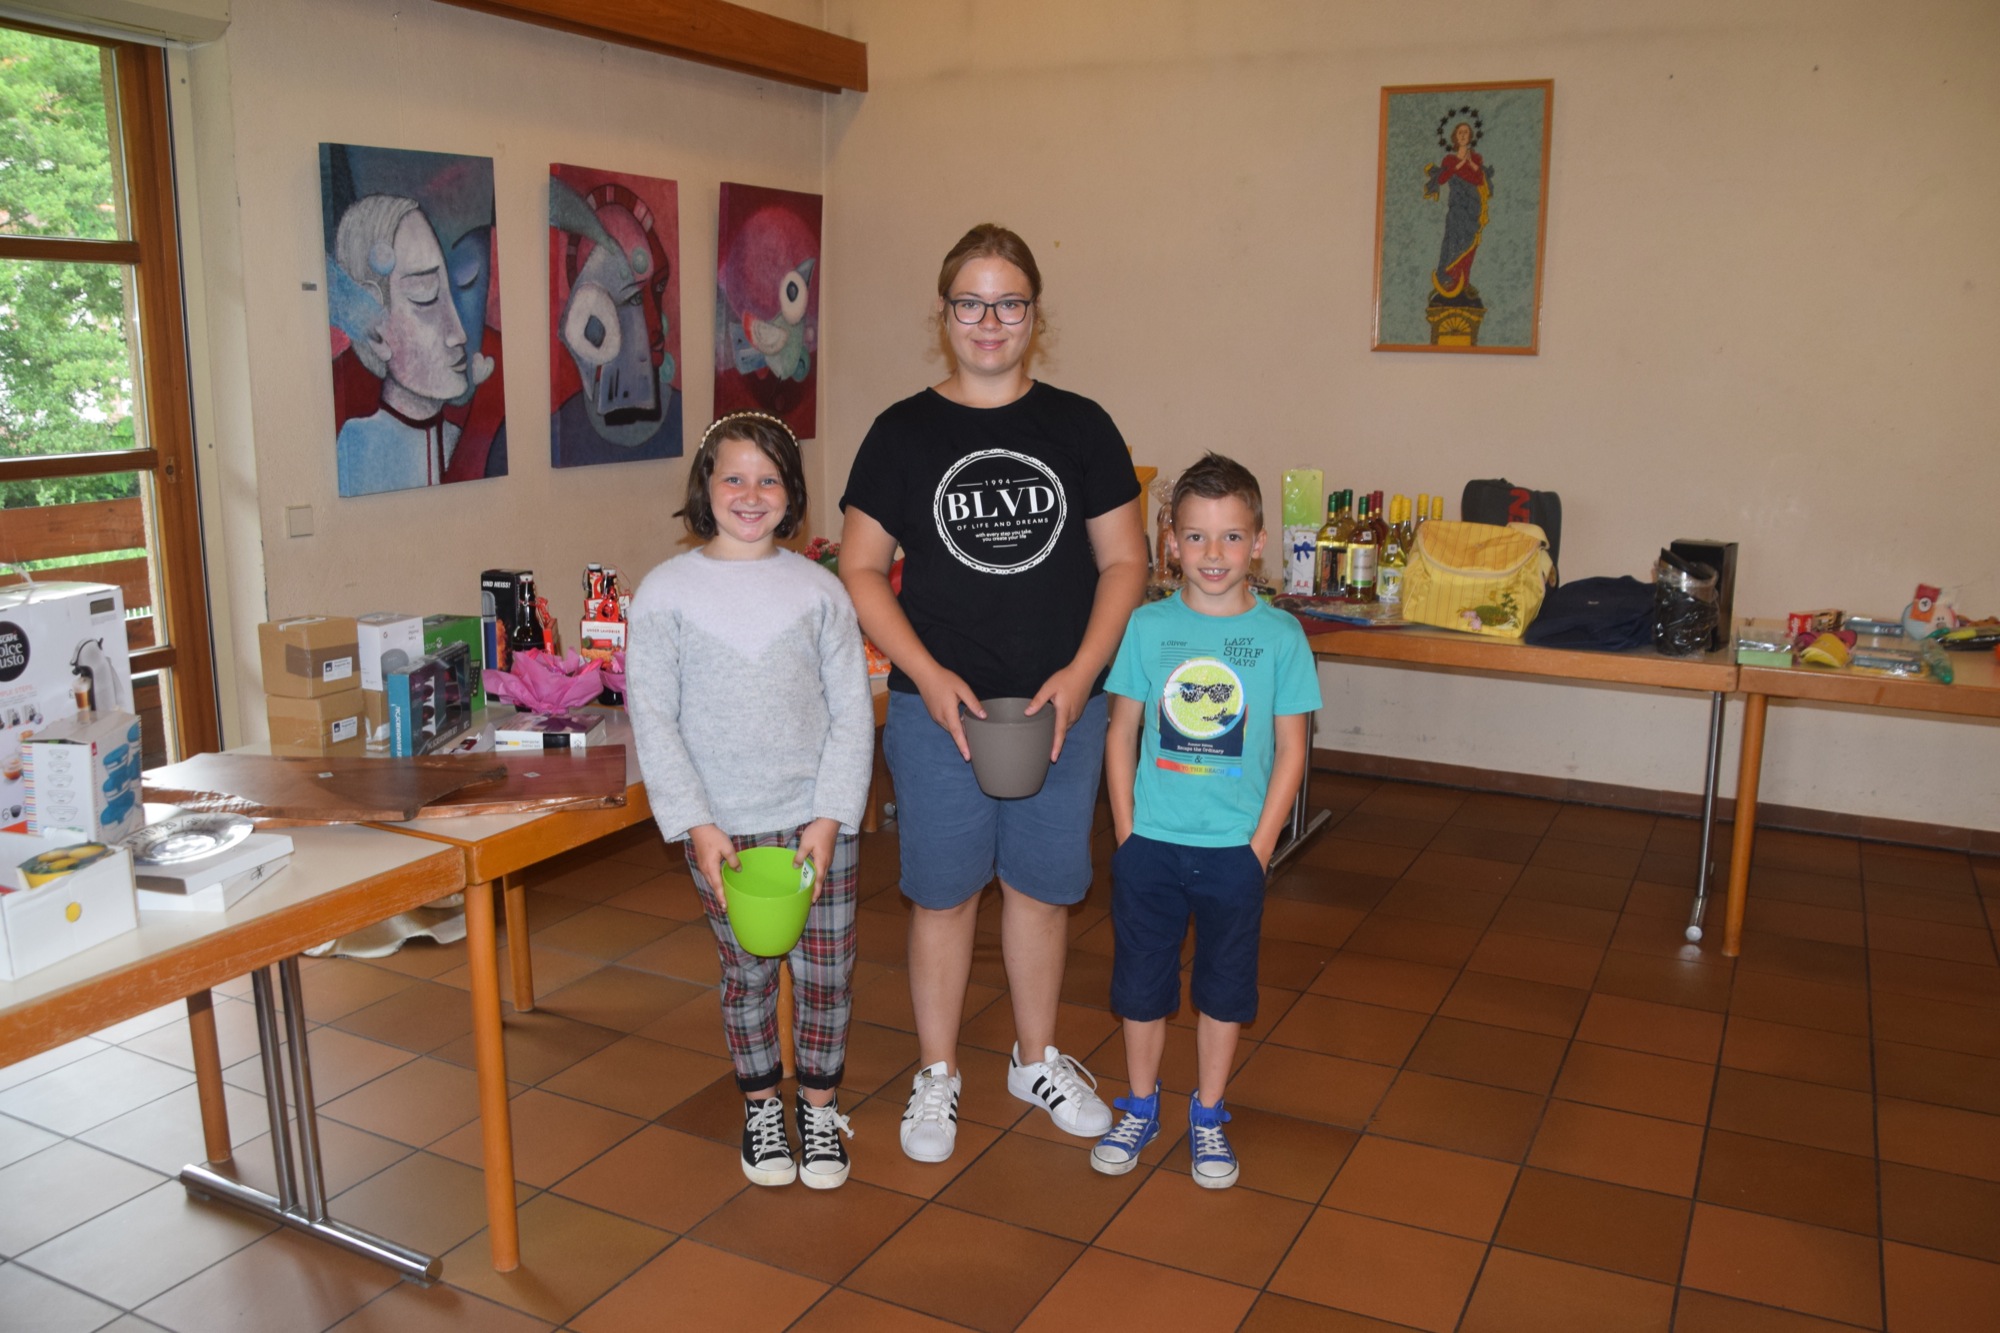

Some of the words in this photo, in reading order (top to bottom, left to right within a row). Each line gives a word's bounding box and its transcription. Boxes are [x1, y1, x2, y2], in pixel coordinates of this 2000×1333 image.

[945, 485, 1055, 522] BLVD
[1016, 517, 1049, 526] DREAMS
[482, 580, 493, 588] UND
[1224, 638, 1255, 647] LAZY
[1223, 646, 1264, 658] SURF
[1229, 657, 1257, 668] DAYS
[1194, 755, 1203, 764] &
